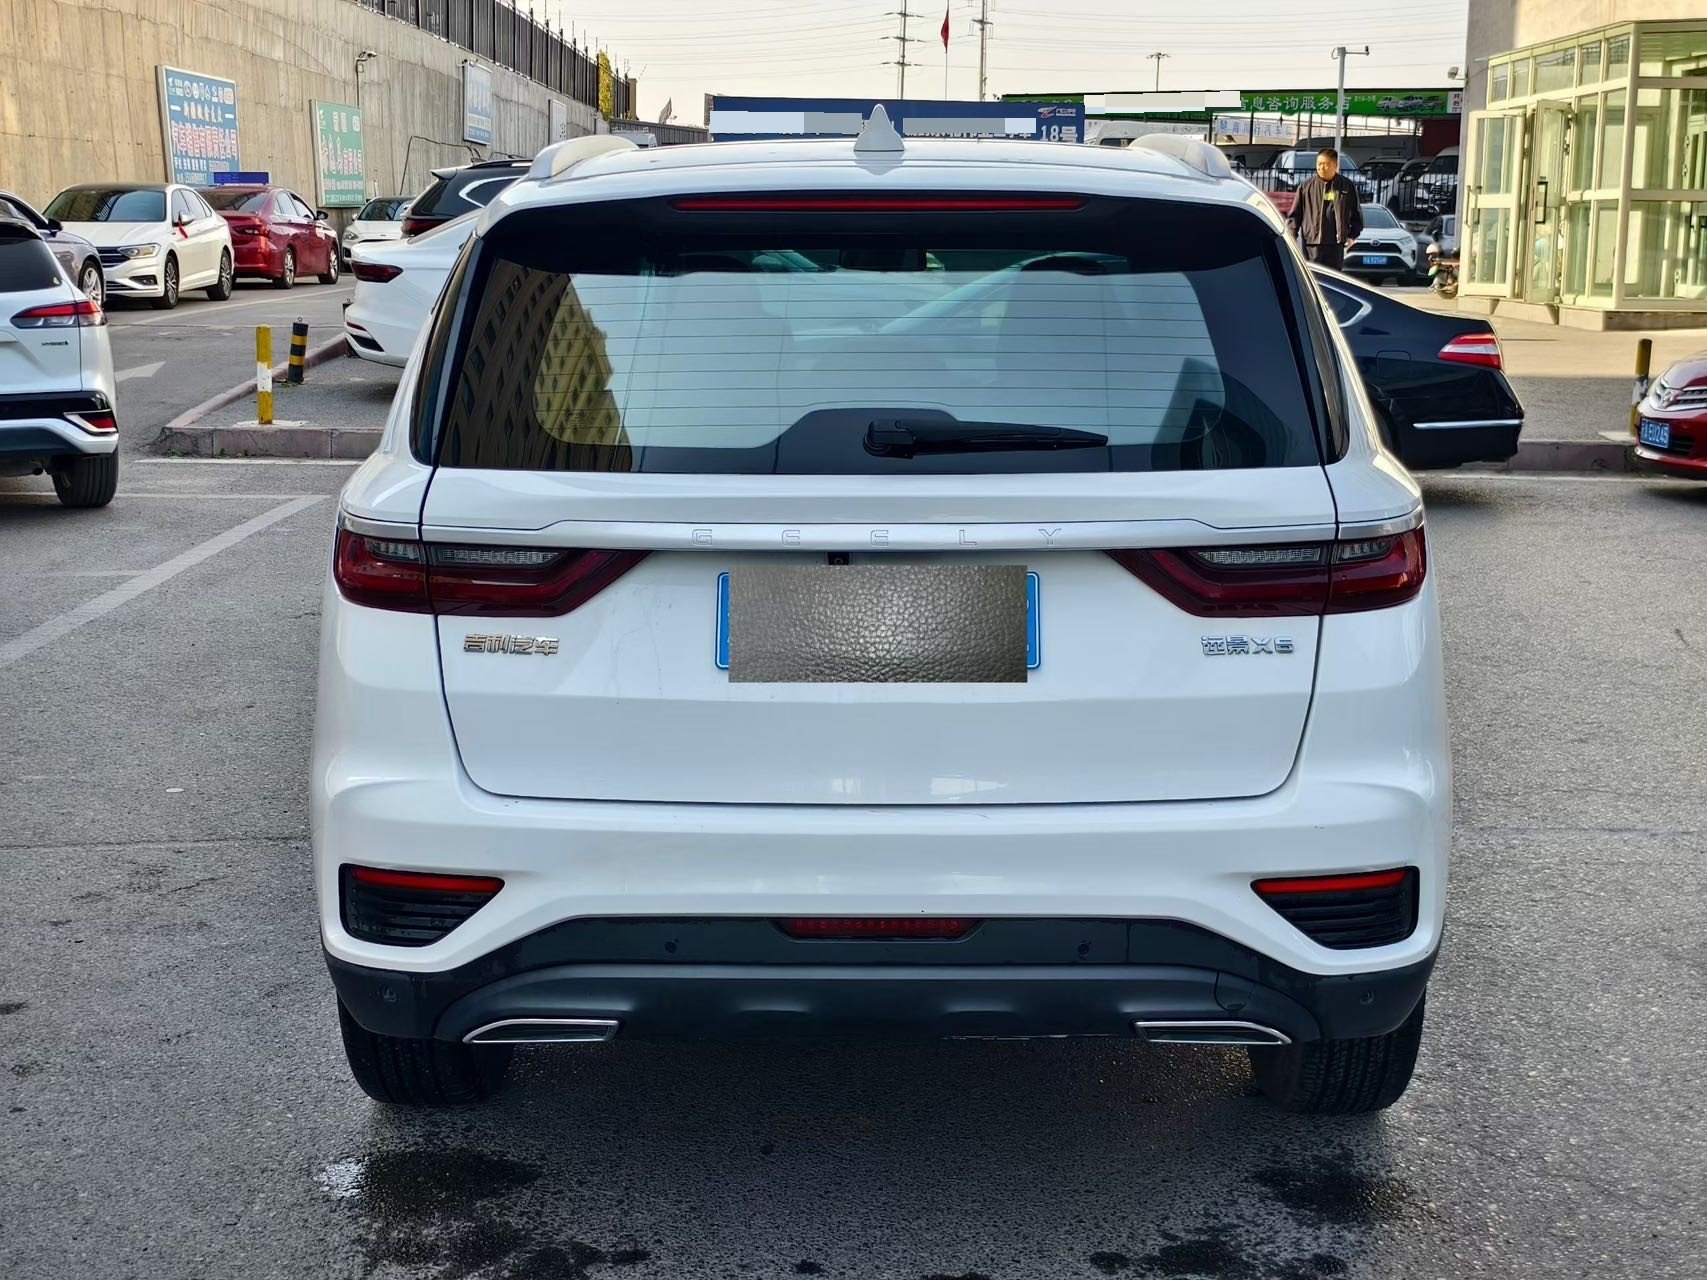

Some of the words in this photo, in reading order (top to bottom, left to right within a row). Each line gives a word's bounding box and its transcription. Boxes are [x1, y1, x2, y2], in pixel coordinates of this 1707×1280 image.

[1040, 125, 1078, 143] 18号
[691, 528, 1062, 546] GEELY
[464, 634, 559, 655] 吉利汽车
[1201, 635, 1294, 655] 远景X6
